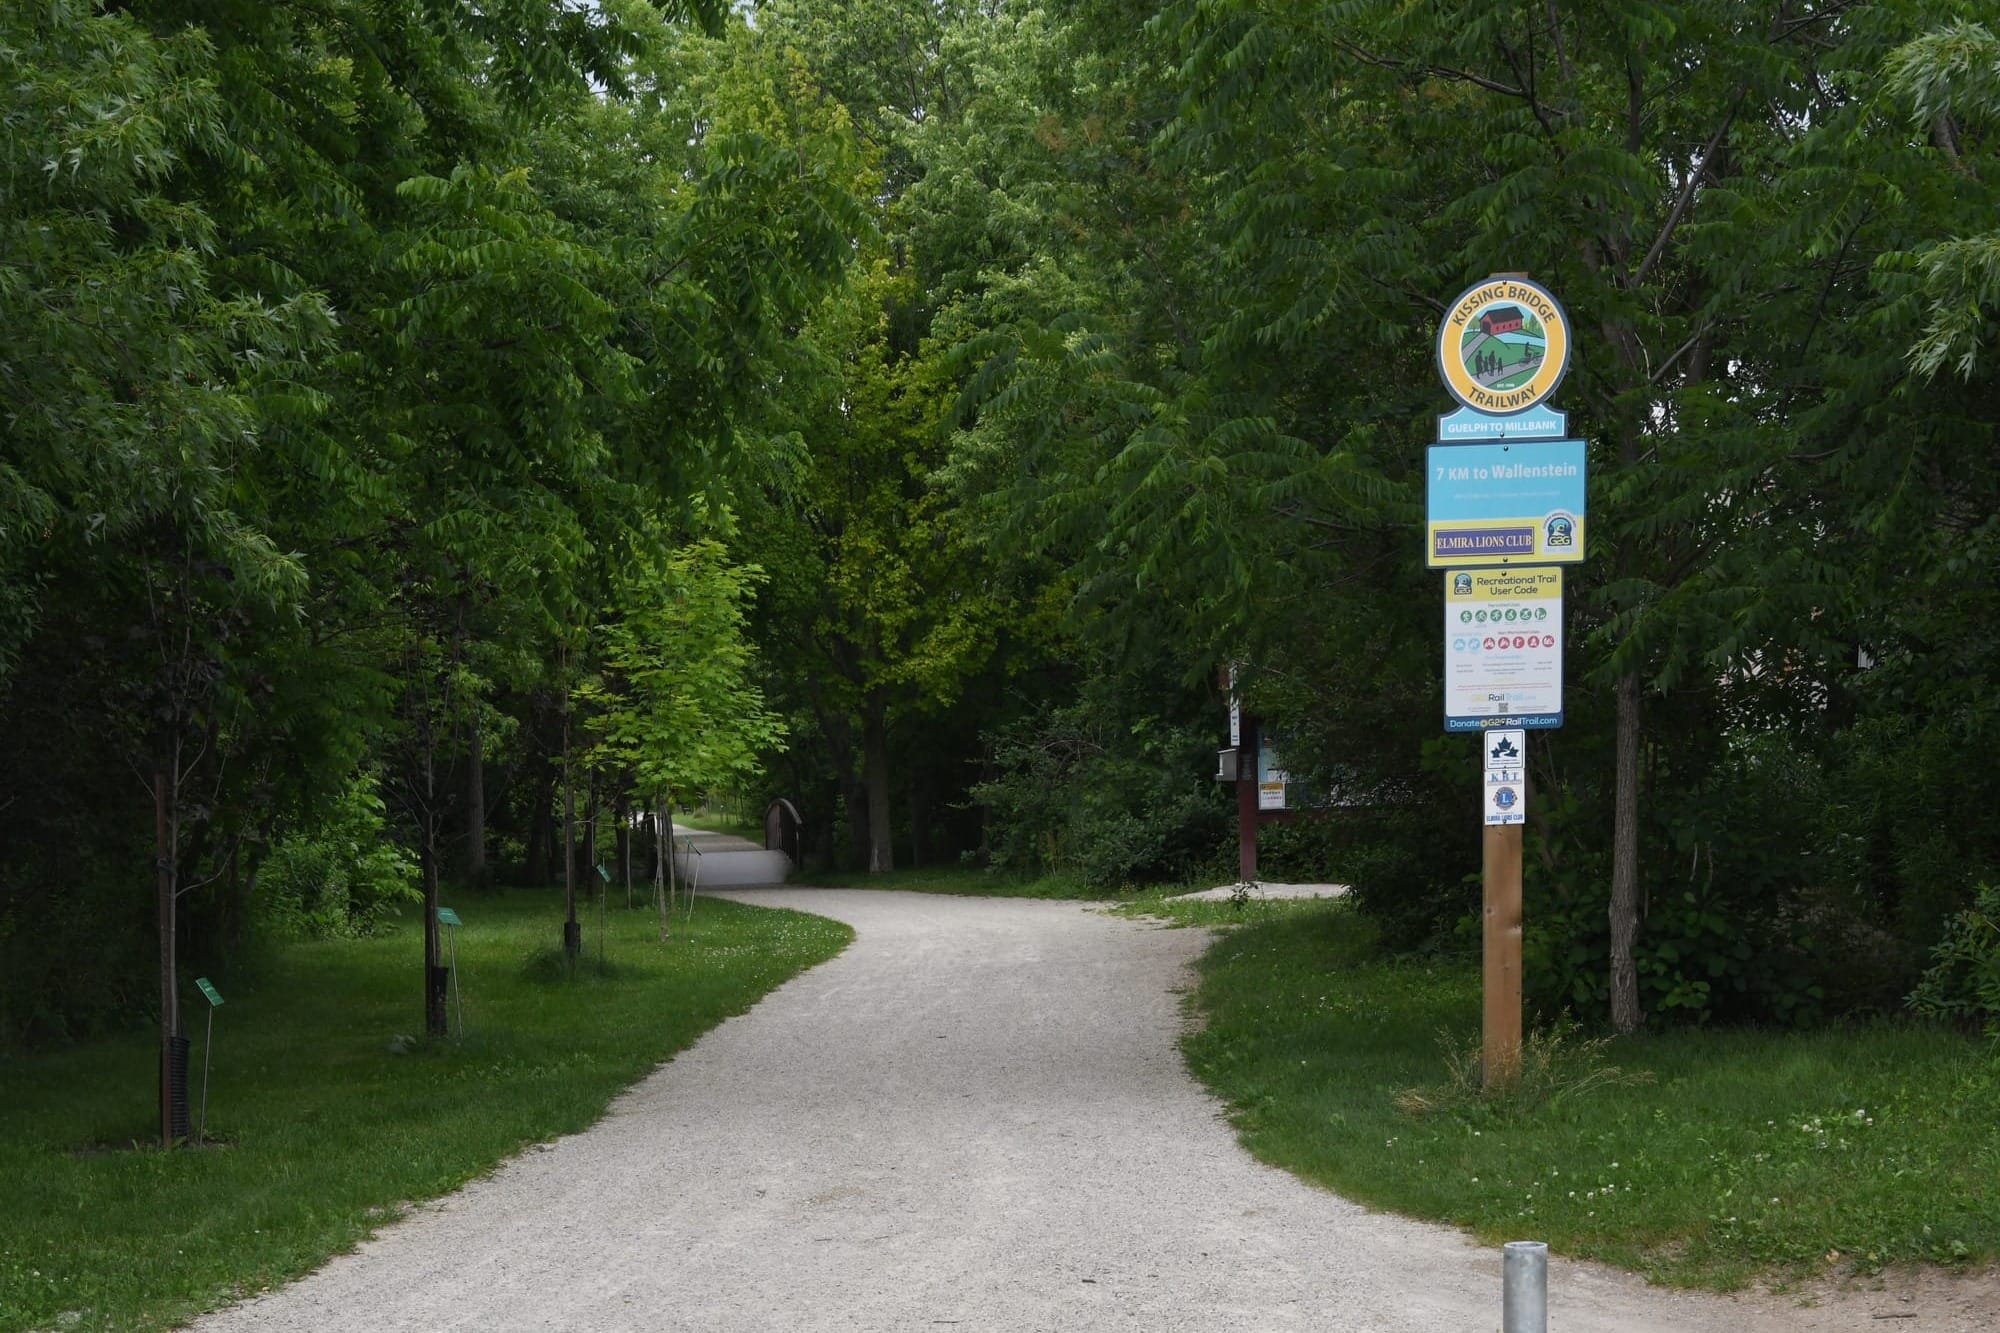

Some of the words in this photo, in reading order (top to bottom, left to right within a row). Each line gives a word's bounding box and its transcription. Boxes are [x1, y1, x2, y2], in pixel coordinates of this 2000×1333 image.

[1452, 286, 1505, 326] KISSING
[1508, 286, 1556, 324] BRIDGE
[1468, 384, 1537, 408] TRAILWAY
[1448, 421, 1488, 433] GUELPH
[1489, 421, 1503, 431] TO
[1505, 419, 1557, 431] MILLBANK
[1437, 467, 1444, 481] 7
[1448, 467, 1469, 480] KM
[1473, 466, 1488, 480] to
[1492, 462, 1577, 479] Wallenstein
[1437, 536, 1474, 549] ELMIRA
[1475, 535, 1504, 548] LIONS
[1506, 534, 1533, 547] CLUB
[1477, 575, 1536, 586] Recreational
[1537, 574, 1557, 584] Trail
[1490, 586, 1512, 595] User
[1514, 585, 1538, 595] Code
